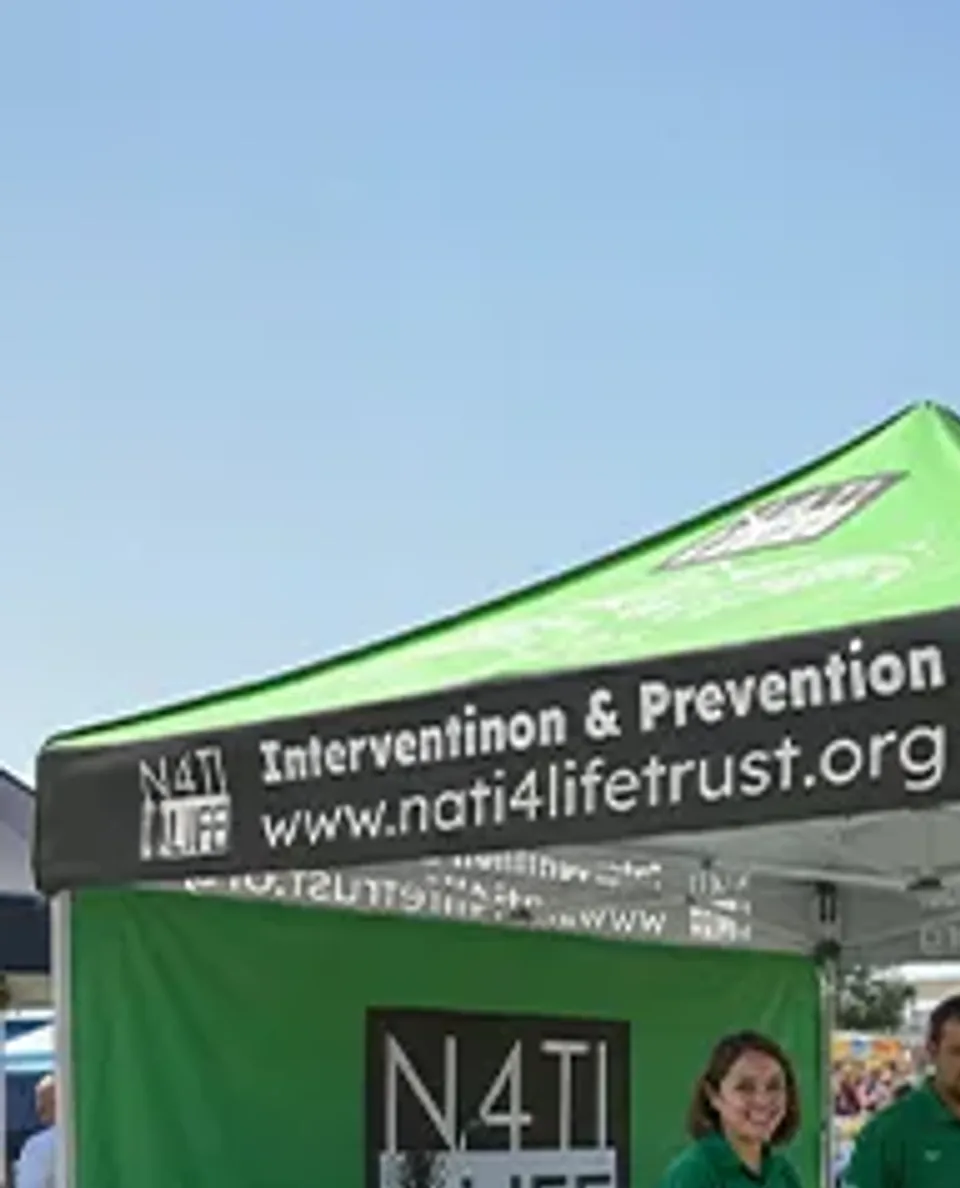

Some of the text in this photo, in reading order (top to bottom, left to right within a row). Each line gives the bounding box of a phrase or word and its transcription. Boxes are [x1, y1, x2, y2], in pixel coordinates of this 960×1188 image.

[259, 637, 946, 786] Interventinon & Prevention
[260, 723, 946, 848] www.nati4lifetrust.org
[386, 1033, 608, 1150] N4TI
